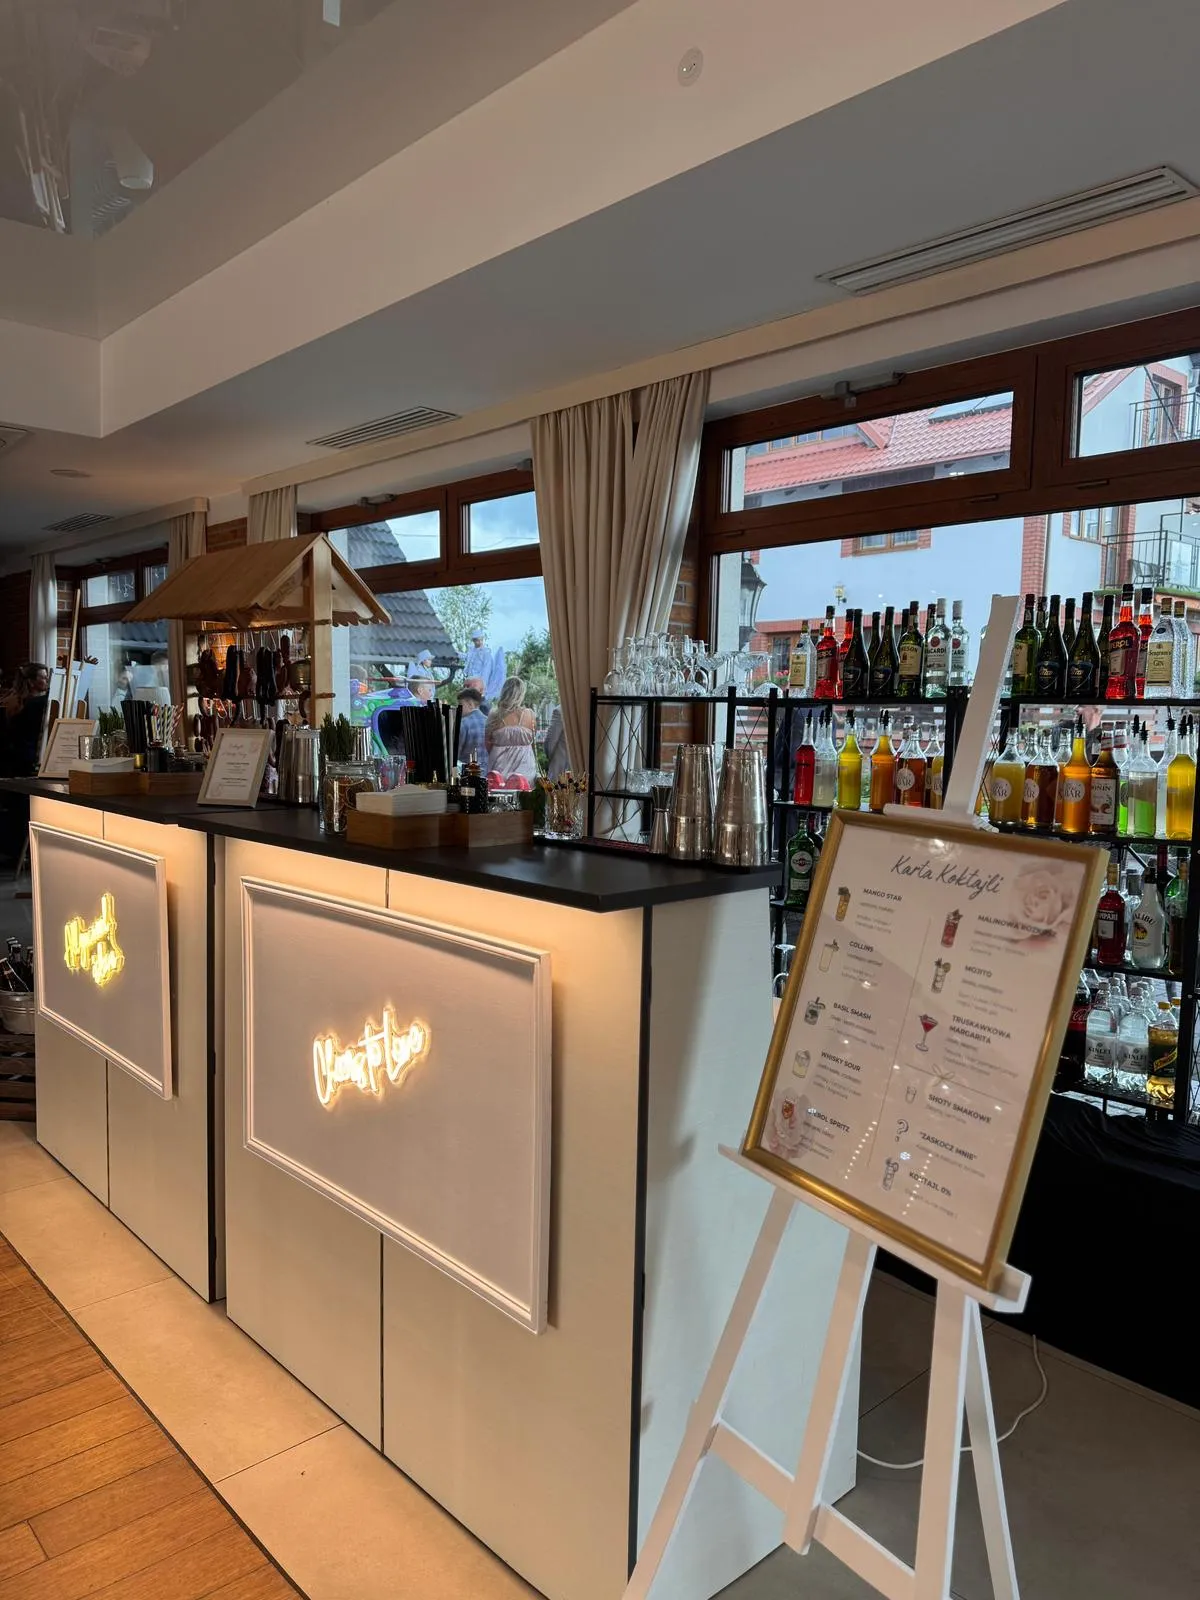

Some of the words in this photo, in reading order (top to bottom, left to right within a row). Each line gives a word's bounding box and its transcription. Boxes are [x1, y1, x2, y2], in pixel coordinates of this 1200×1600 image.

[1109, 639, 1130, 650] EROL
[1064, 790, 1081, 798] BAR
[891, 855, 933, 881] Karta
[936, 863, 1005, 901] Koktajli
[863, 888, 886, 898] MANGO
[886, 893, 903, 902] STAR
[977, 914, 1019, 930] MALINOWA
[849, 941, 874, 953] COLLINS
[964, 965, 993, 979] MOJITO
[833, 1002, 850, 1013] BASIL
[849, 1008, 872, 1021] SMASH
[949, 1025, 992, 1045] MARGARITA
[952, 1014, 1012, 1040] TRUSKAWKOWA
[821, 1051, 844, 1065] WHISKY
[844, 1060, 861, 1072] SOUR
[928, 1094, 952, 1108] SHOTY
[952, 1103, 992, 1124] SMAKOWE
[829, 1118, 851, 1133] SPRITZ
